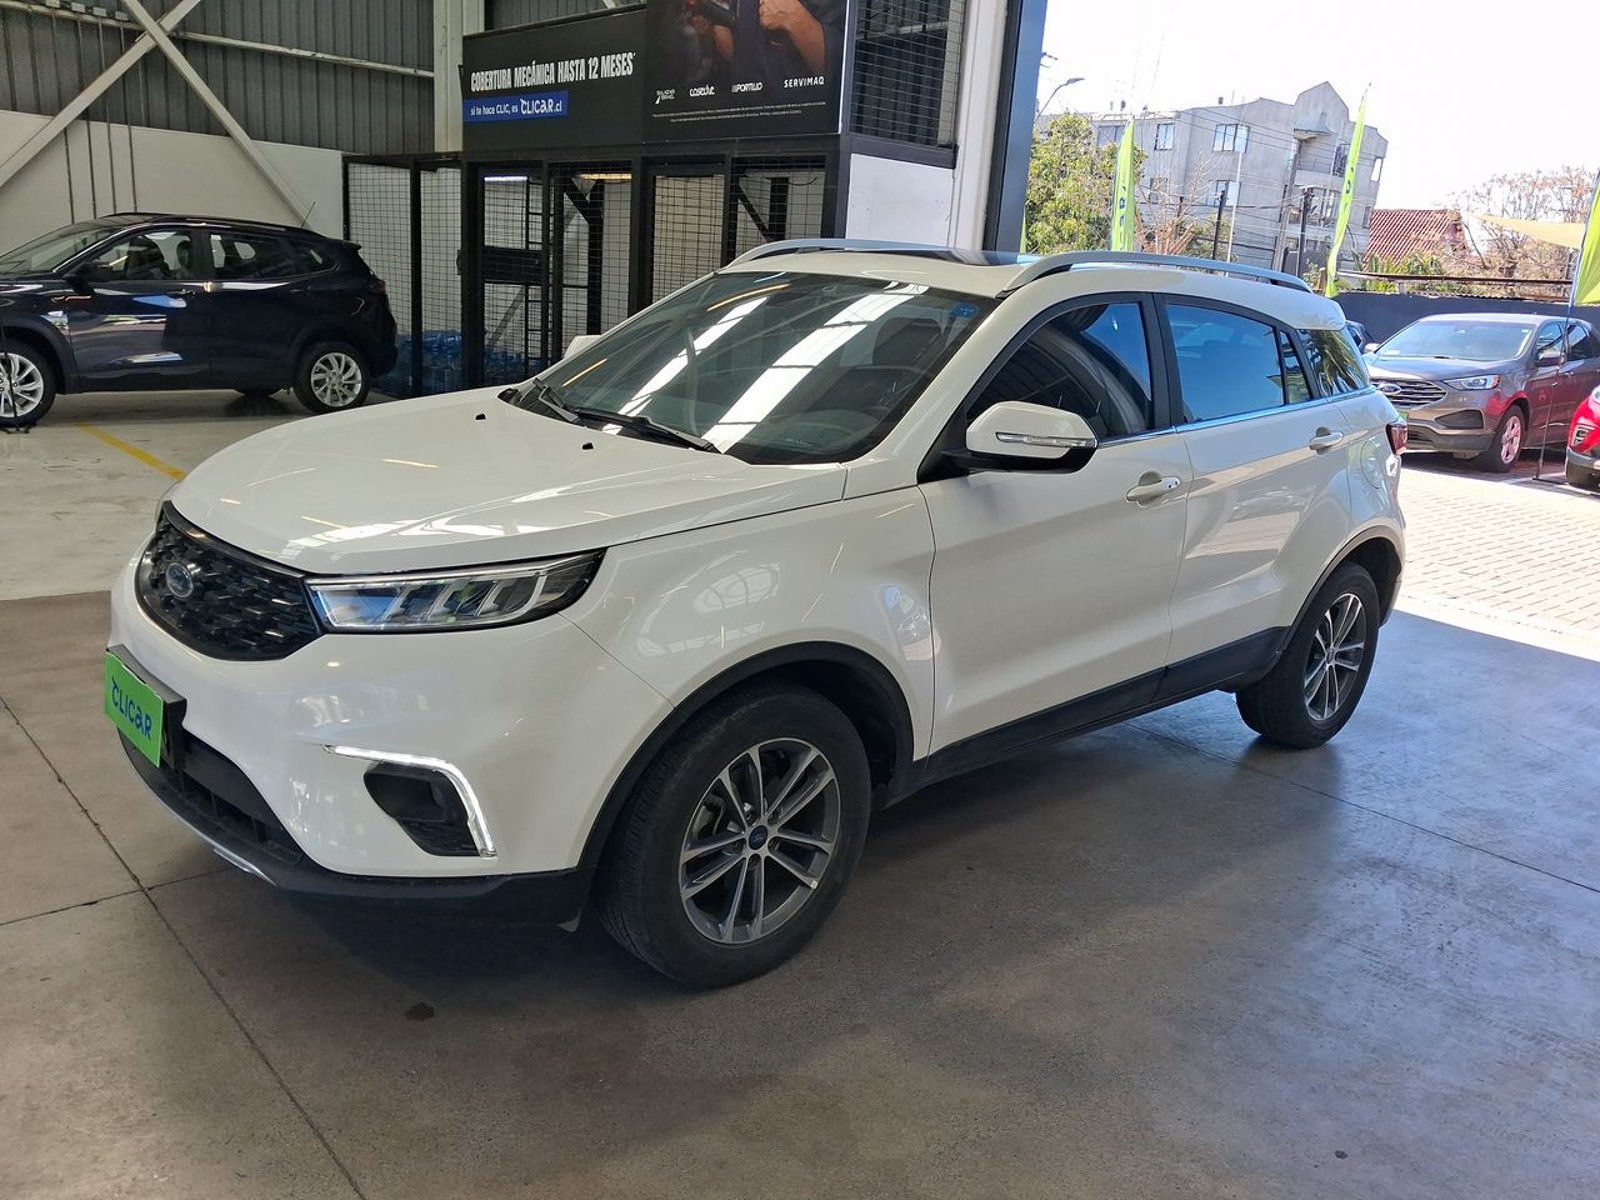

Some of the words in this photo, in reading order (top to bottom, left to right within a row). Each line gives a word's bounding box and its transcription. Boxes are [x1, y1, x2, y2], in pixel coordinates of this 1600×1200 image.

[470, 68, 512, 92] COBERTURA
[514, 59, 555, 88] MECÁNICA
[557, 58, 586, 83] HASTA
[588, 56, 599, 80] 12
[783, 76, 825, 89] SERVIMAQ
[482, 105, 495, 115] hace
